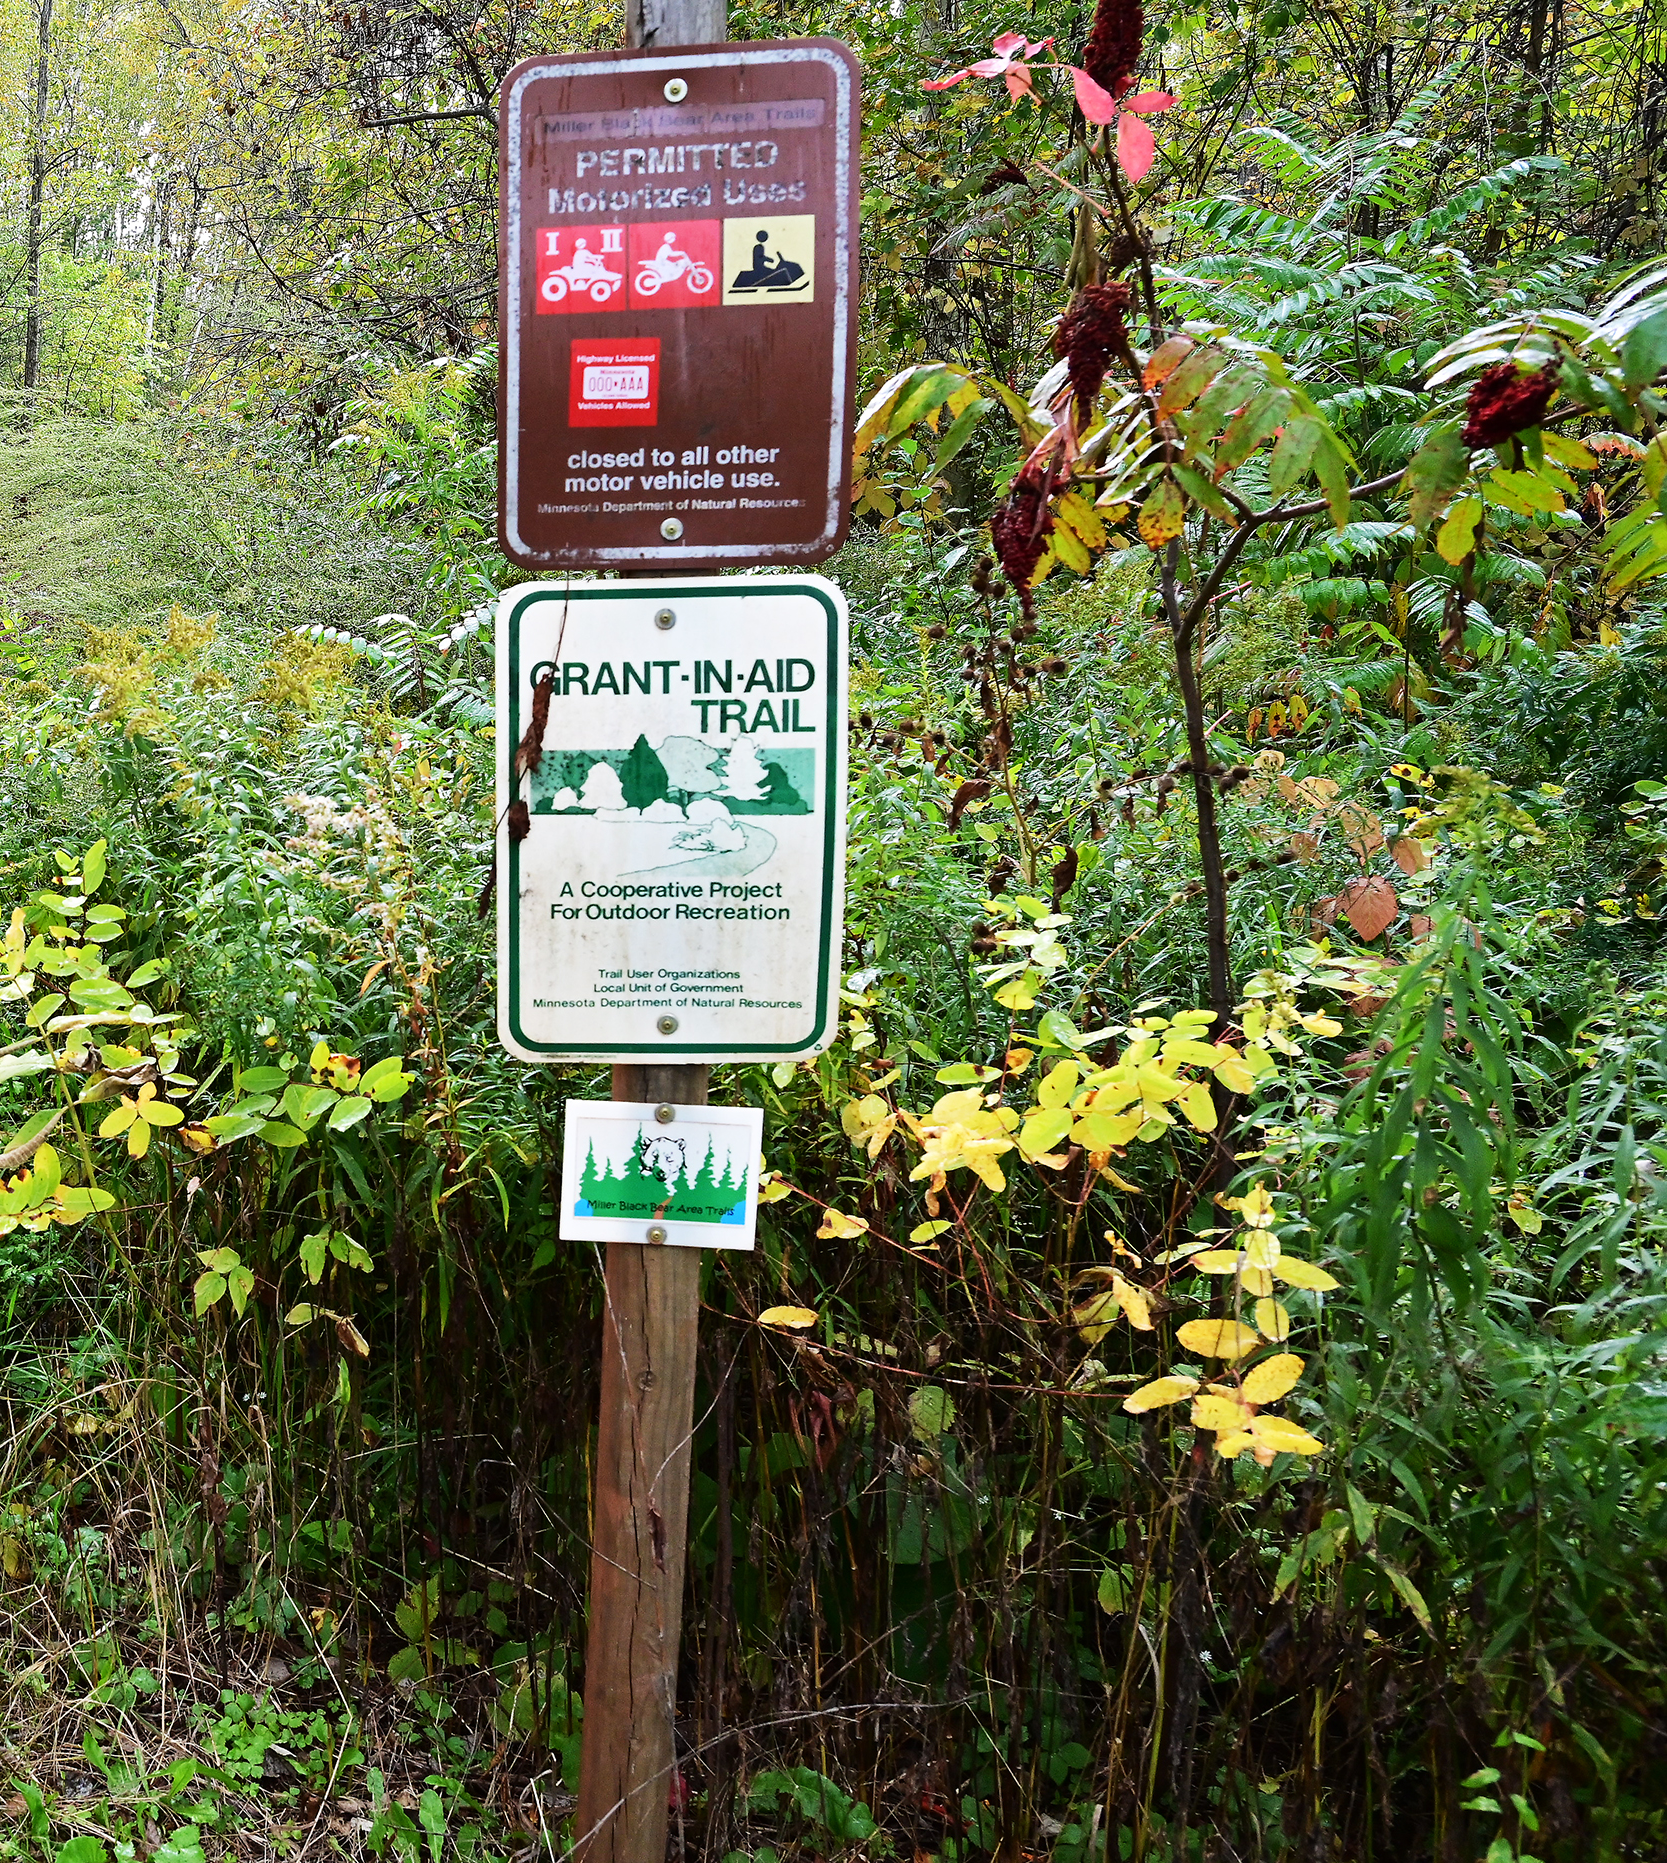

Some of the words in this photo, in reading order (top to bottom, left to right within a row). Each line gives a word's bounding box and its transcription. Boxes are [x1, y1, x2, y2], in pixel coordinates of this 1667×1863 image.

[544, 120, 593, 134] Miller
[711, 110, 754, 124] Area
[764, 107, 816, 121] Trails
[576, 140, 779, 178] PERMITTED
[547, 182, 712, 214] Motorized
[724, 178, 807, 205] Uses
[545, 231, 560, 256] I
[600, 228, 624, 253] II
[577, 354, 615, 364] Highway
[615, 353, 656, 363] Licensed
[577, 402, 614, 410] Vehicles
[615, 401, 651, 410] Allowed
[567, 448, 646, 469] closed
[651, 448, 675, 467] to
[681, 445, 710, 466] all
[715, 444, 780, 465] other
[564, 474, 634, 493] motor
[640, 469, 725, 491] vehicle
[731, 471, 781, 488] use.
[602, 500, 674, 514] Department
[675, 498, 690, 511] of
[691, 498, 737, 510] Natural
[690, 698, 816, 733] TRAIL
[559, 882, 574, 898] A
[581, 881, 703, 900] Cooperative
[709, 881, 783, 901] Project
[550, 903, 582, 920] For
[585, 903, 671, 920] Outdoor
[675, 904, 791, 920] Recreation
[598, 968, 623, 979] Trail
[627, 968, 654, 979] User
[657, 968, 741, 981] Organizations
[593, 983, 625, 993] Local
[628, 983, 652, 993] Unit
[654, 983, 667, 993] of
[670, 982, 744, 993] Government
[532, 998, 596, 1008] Minnesota
[600, 997, 672, 1009] Department
[675, 997, 688, 1007] of
[691, 997, 735, 1008] Natural
[739, 998, 803, 1009] Resources
[586, 1199, 617, 1210] Miller
[619, 1200, 648, 1211] Black
[650, 1202, 674, 1213] Bear
[676, 1204, 704, 1215] Area
[705, 1205, 735, 1216] Trails
